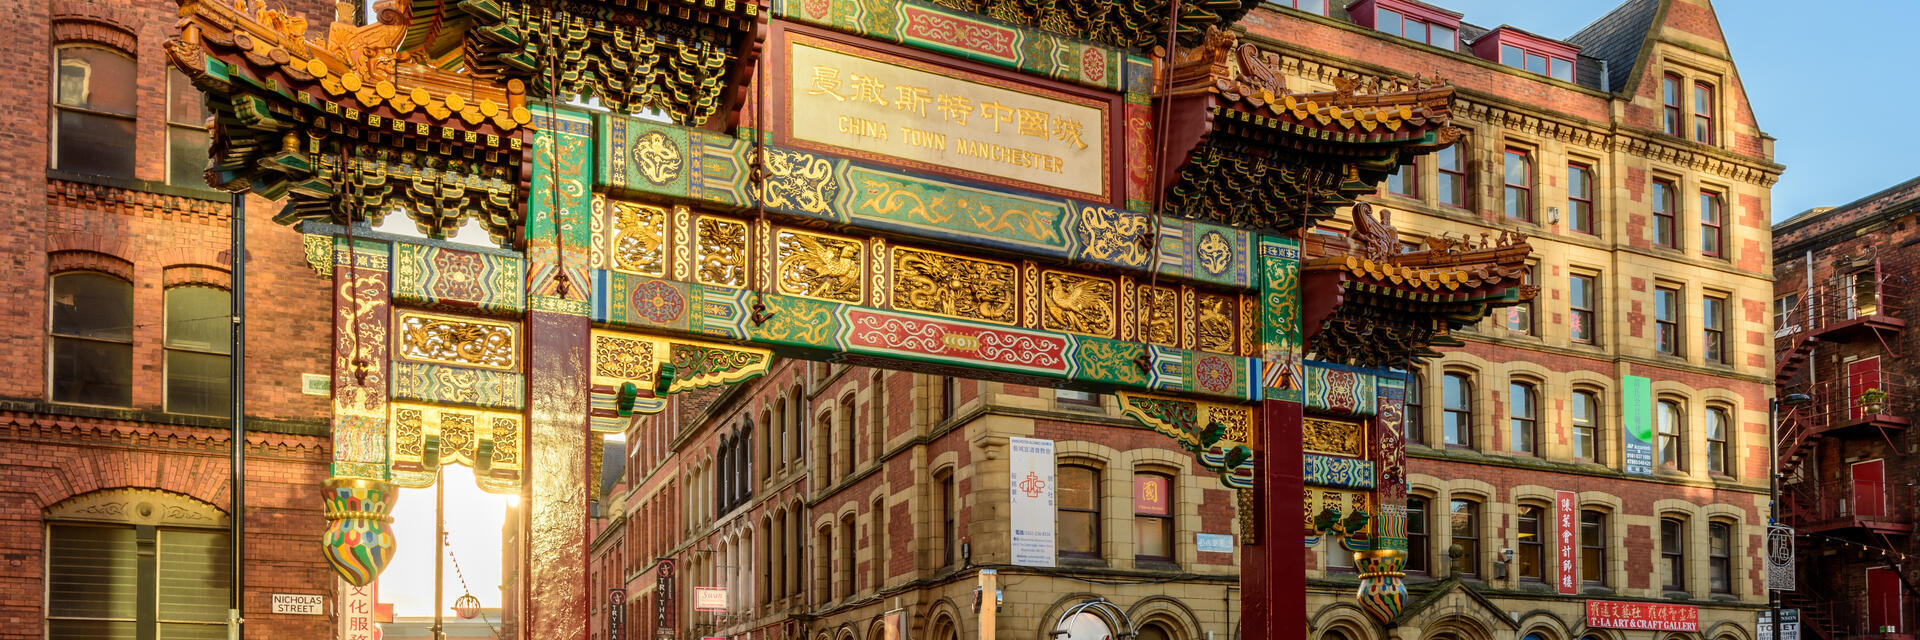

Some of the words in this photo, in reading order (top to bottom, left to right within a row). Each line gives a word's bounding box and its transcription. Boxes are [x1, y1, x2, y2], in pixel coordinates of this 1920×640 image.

[808, 65, 1089, 150] 曼徹斯特中國城
[838, 115, 889, 141] CHINA
[901, 127, 946, 151] TOWN
[957, 137, 1064, 174] MANCHESTER
[274, 596, 322, 605] NICHOLAS
[278, 604, 315, 613] STREET
[1613, 618, 1629, 628] ART
[1629, 619, 1637, 627] &
[1637, 619, 1663, 629] CRAFT
[1664, 621, 1696, 631] GALLERY
